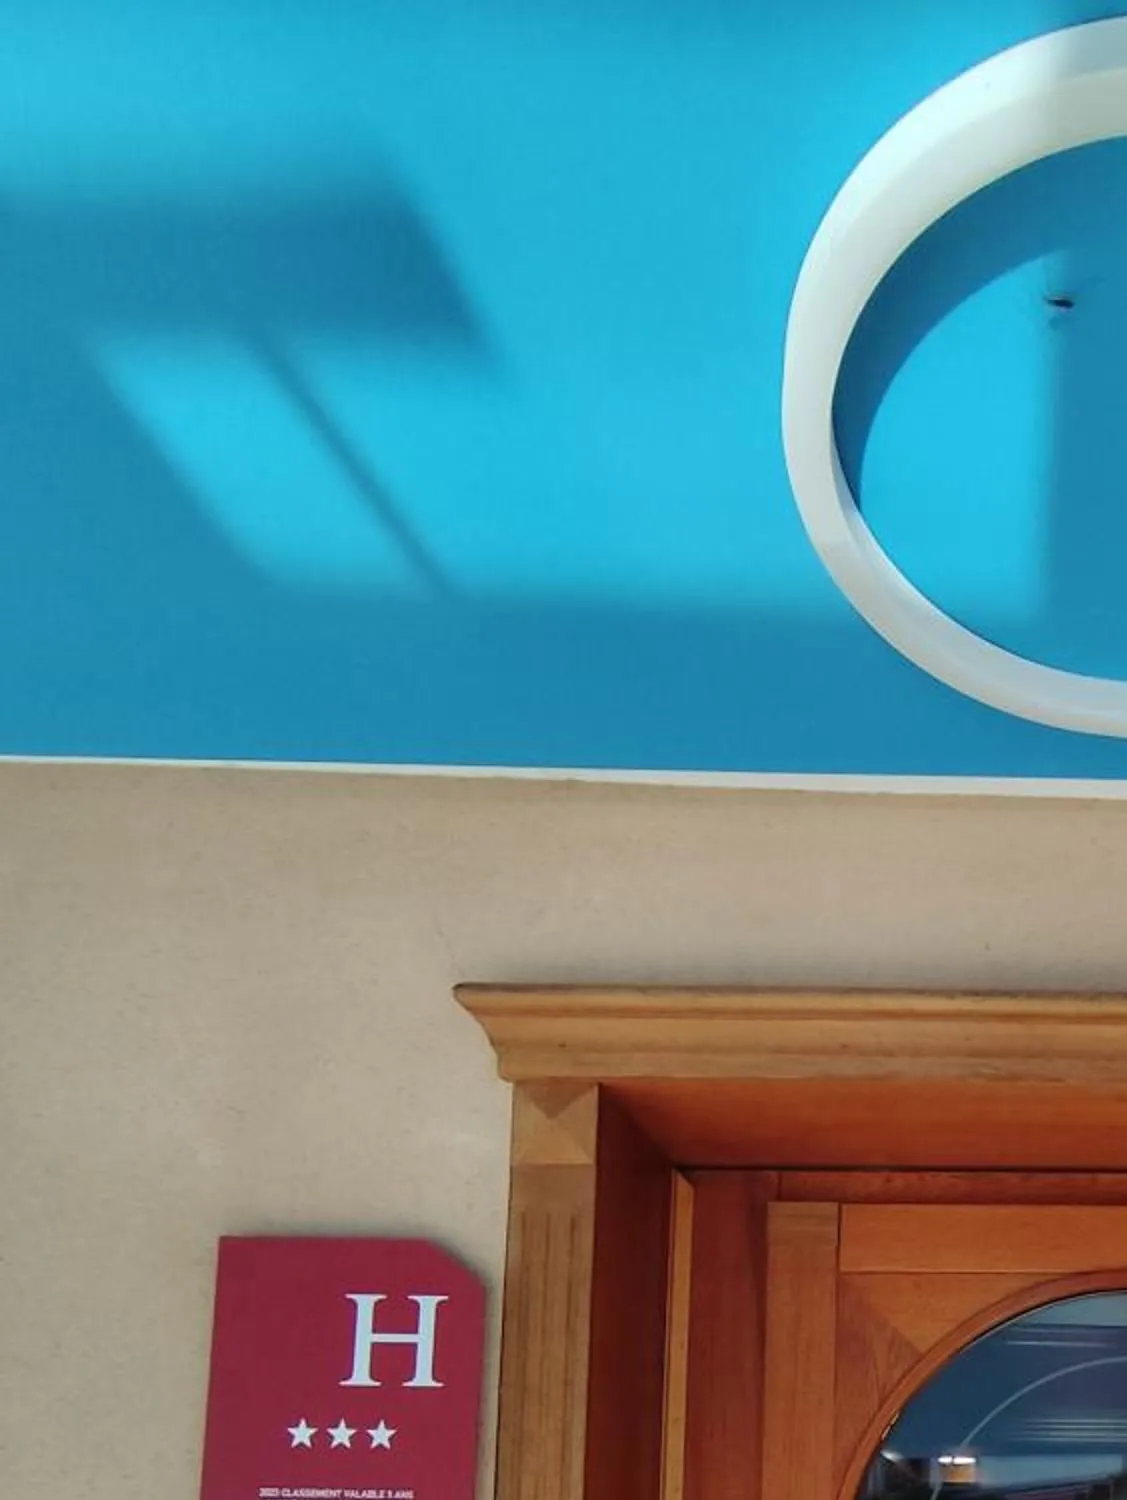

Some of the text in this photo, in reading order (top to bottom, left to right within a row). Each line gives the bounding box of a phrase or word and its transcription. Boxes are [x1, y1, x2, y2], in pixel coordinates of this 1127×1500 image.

[338, 1293, 449, 1387] H
[281, 1488, 341, 1499] CLASSEMENT
[344, 1489, 385, 1499] VALABLE
